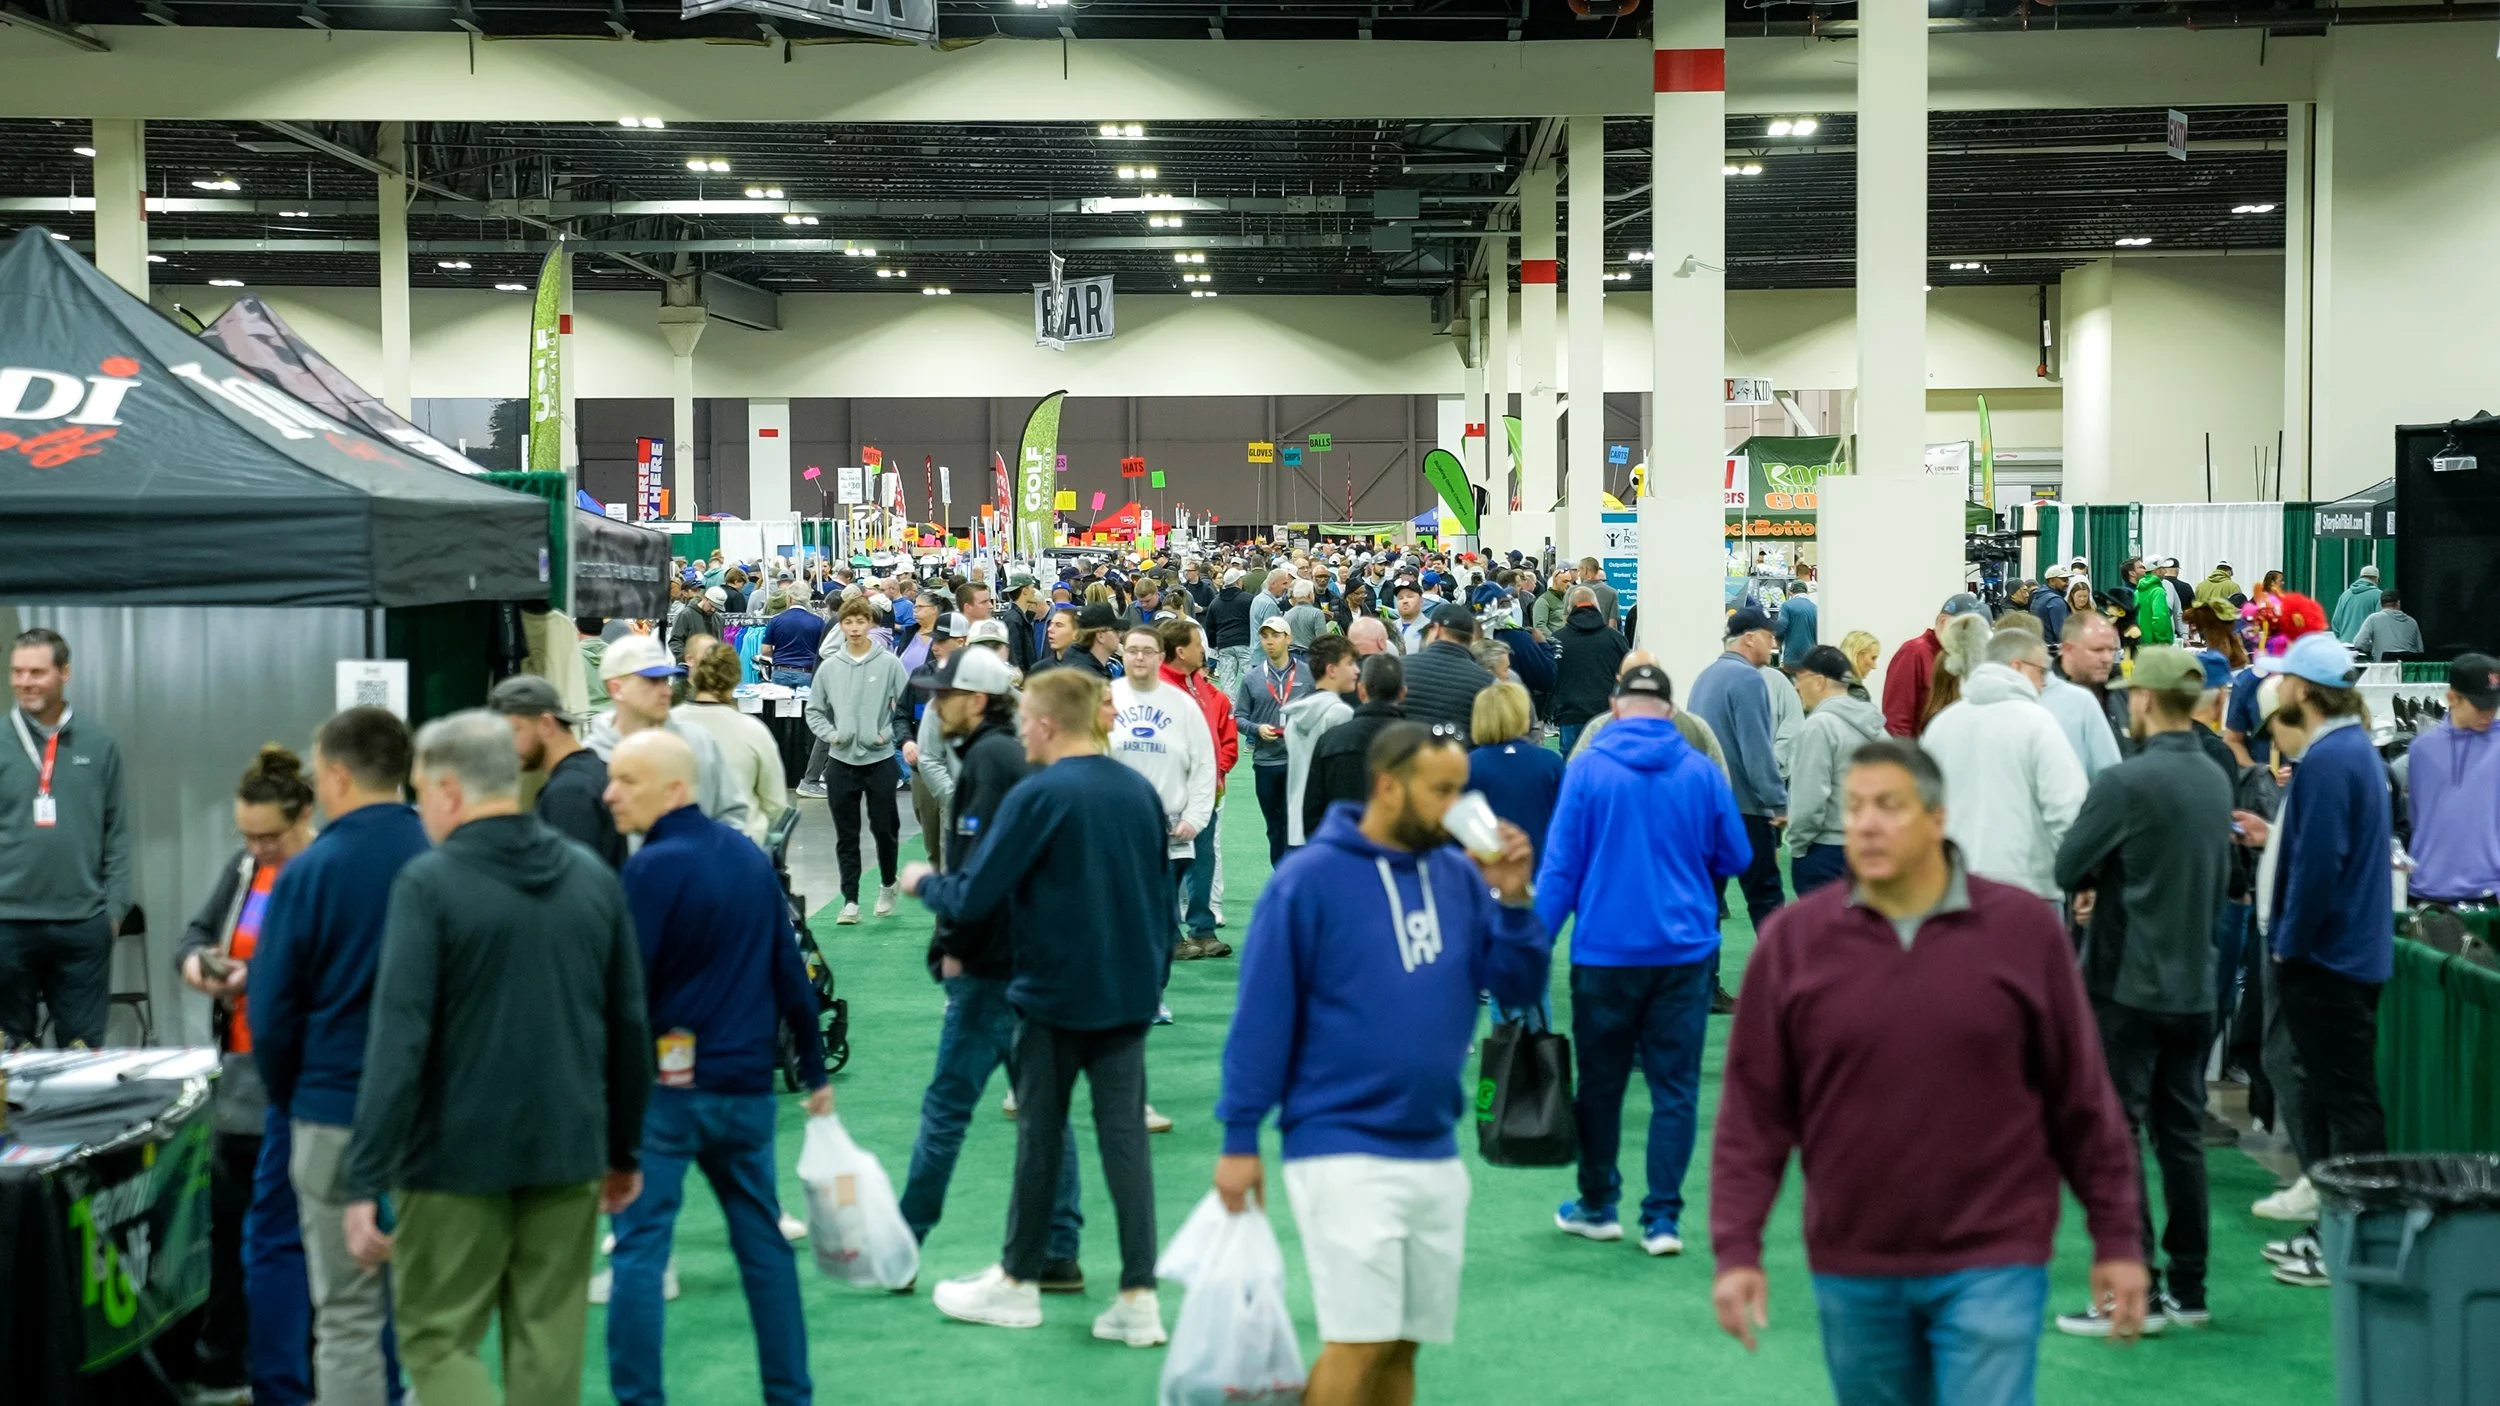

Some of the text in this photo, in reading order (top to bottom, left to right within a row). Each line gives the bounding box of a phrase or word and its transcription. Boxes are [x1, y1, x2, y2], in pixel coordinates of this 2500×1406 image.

[1309, 439, 1331, 448] BALLS
[1248, 448, 1273, 457] GLOVES
[1284, 452, 1301, 462] GRIPS
[1610, 450, 1628, 460] CARTS
[648, 442, 664, 504] HERE
[1122, 461, 1145, 473] HATS
[1025, 447, 1043, 512] GOLF
[1115, 706, 1172, 730] PISTONS
[1123, 741, 1167, 754] BASKETBALL
